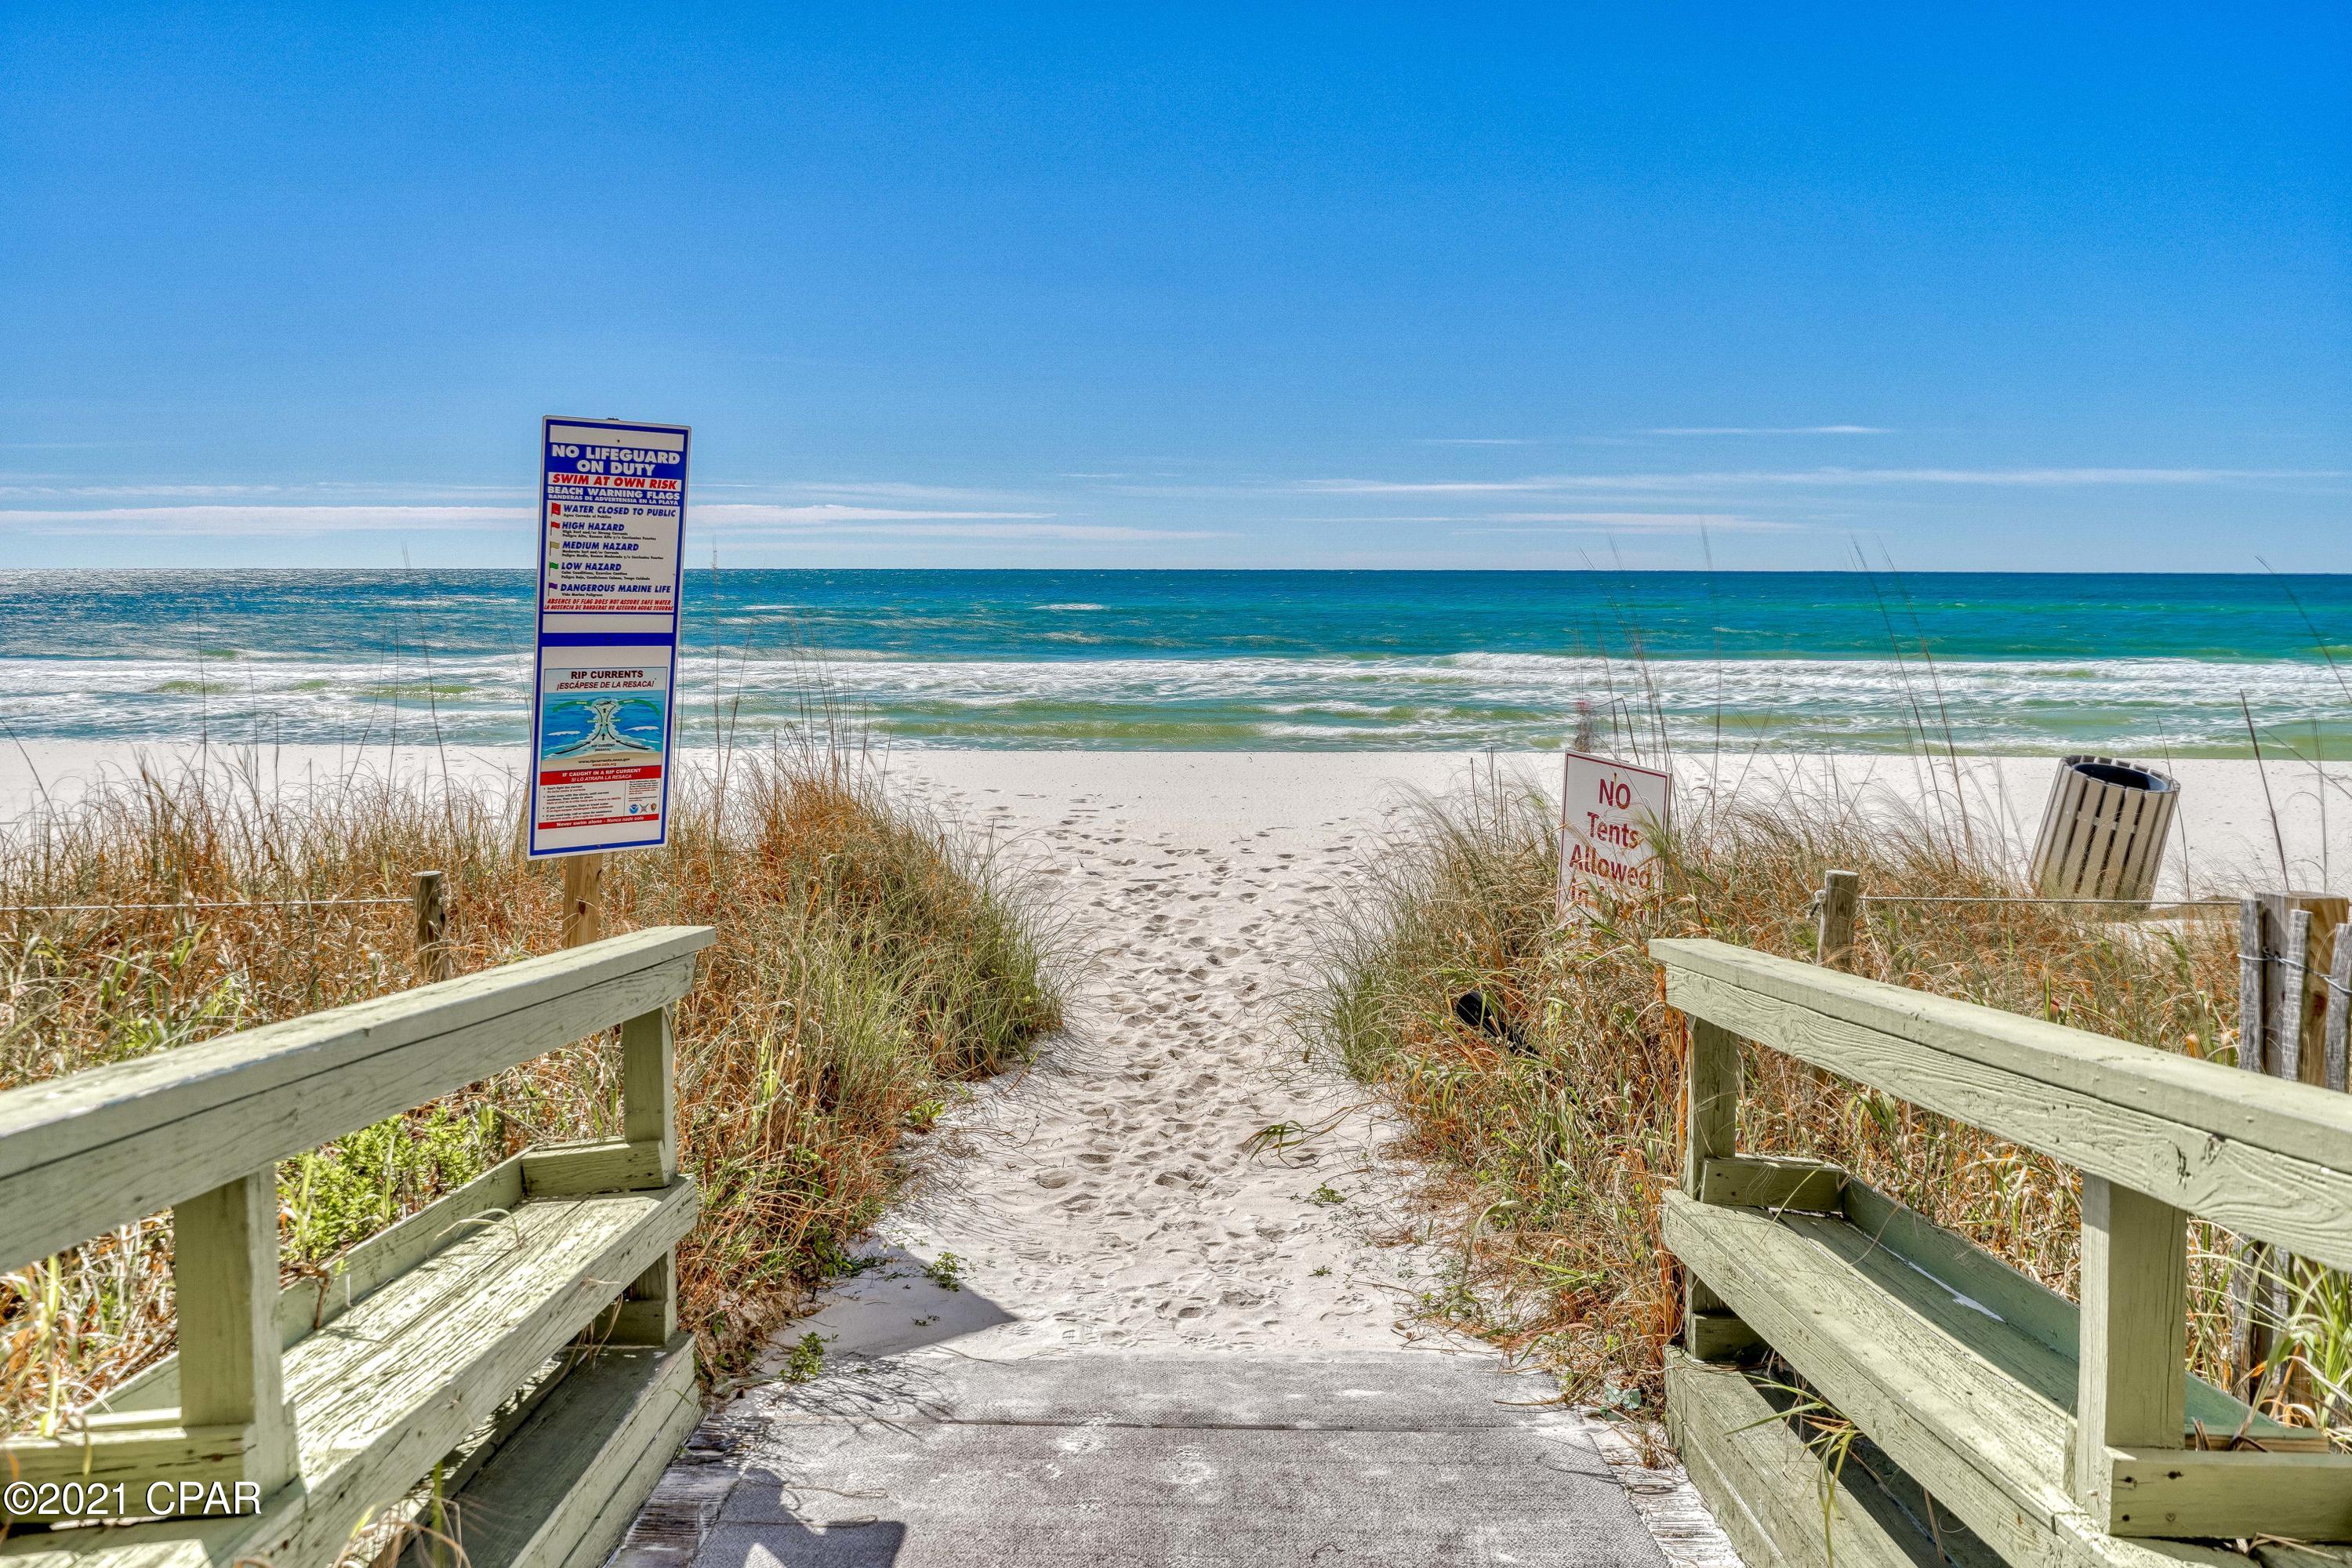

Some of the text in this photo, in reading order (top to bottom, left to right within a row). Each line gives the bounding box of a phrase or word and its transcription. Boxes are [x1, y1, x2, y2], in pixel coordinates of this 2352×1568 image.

[552, 445, 681, 464] NO LIFEGUARD
[577, 459, 656, 476] ON DUTY
[552, 474, 677, 490] SWIM AT OWN RISK
[547, 485, 680, 500] BEACH WARNING FLAGS
[564, 504, 676, 517] WATER CLOSED TO PUBLIC
[561, 521, 625, 532] HIGH HAZARD
[562, 541, 639, 551] MEDIUM HAZARD
[561, 583, 615, 592] DANGEROUS
[618, 584, 652, 593] MARINE
[590, 670, 644, 679] CURRENTS
[557, 681, 599, 691] ¡ESCÁPESE
[1599, 779, 1631, 810] NO
[1587, 811, 1641, 849] Tents
[1569, 844, 1652, 889] Allowed
